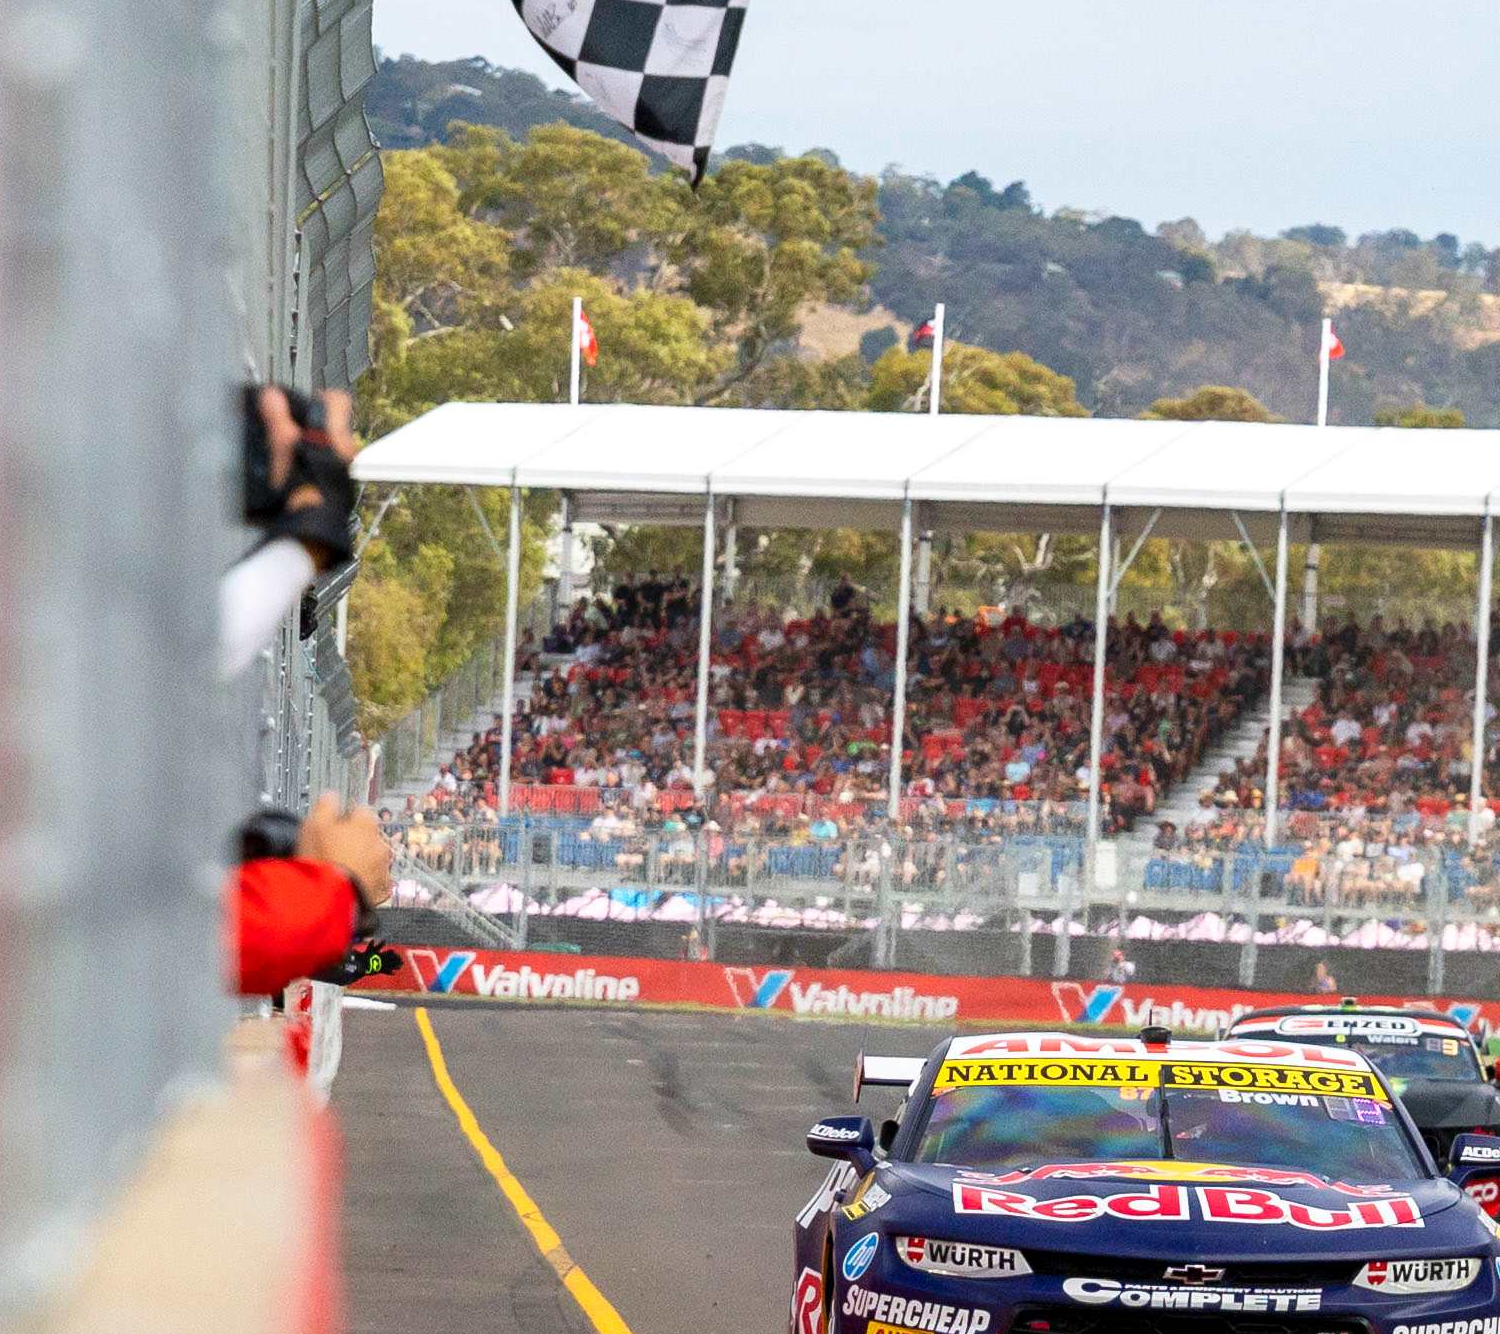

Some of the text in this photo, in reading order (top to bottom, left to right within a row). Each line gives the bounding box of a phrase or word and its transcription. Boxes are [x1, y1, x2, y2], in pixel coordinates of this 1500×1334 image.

[470, 963, 640, 1002] Valvoline
[789, 981, 959, 1020] Valvoline
[1121, 997, 1254, 1033] Valvol
[1327, 1020, 1406, 1030] ENZED
[1367, 1033, 1419, 1046] Waters
[1442, 1038, 1459, 1057] 3
[946, 1063, 1367, 1096] NATIONAL STORAGE
[1118, 1086, 1155, 1101] 87
[1217, 1088, 1319, 1108] Brown
[810, 1122, 861, 1140] ACDelco
[953, 1182, 1190, 1222] Red
[1195, 1186, 1425, 1231] Bull
[846, 1234, 874, 1279] hp
[1062, 1277, 1322, 1311] COMPLETE
[1178, 1286, 1251, 1294] EQUIPMENT
